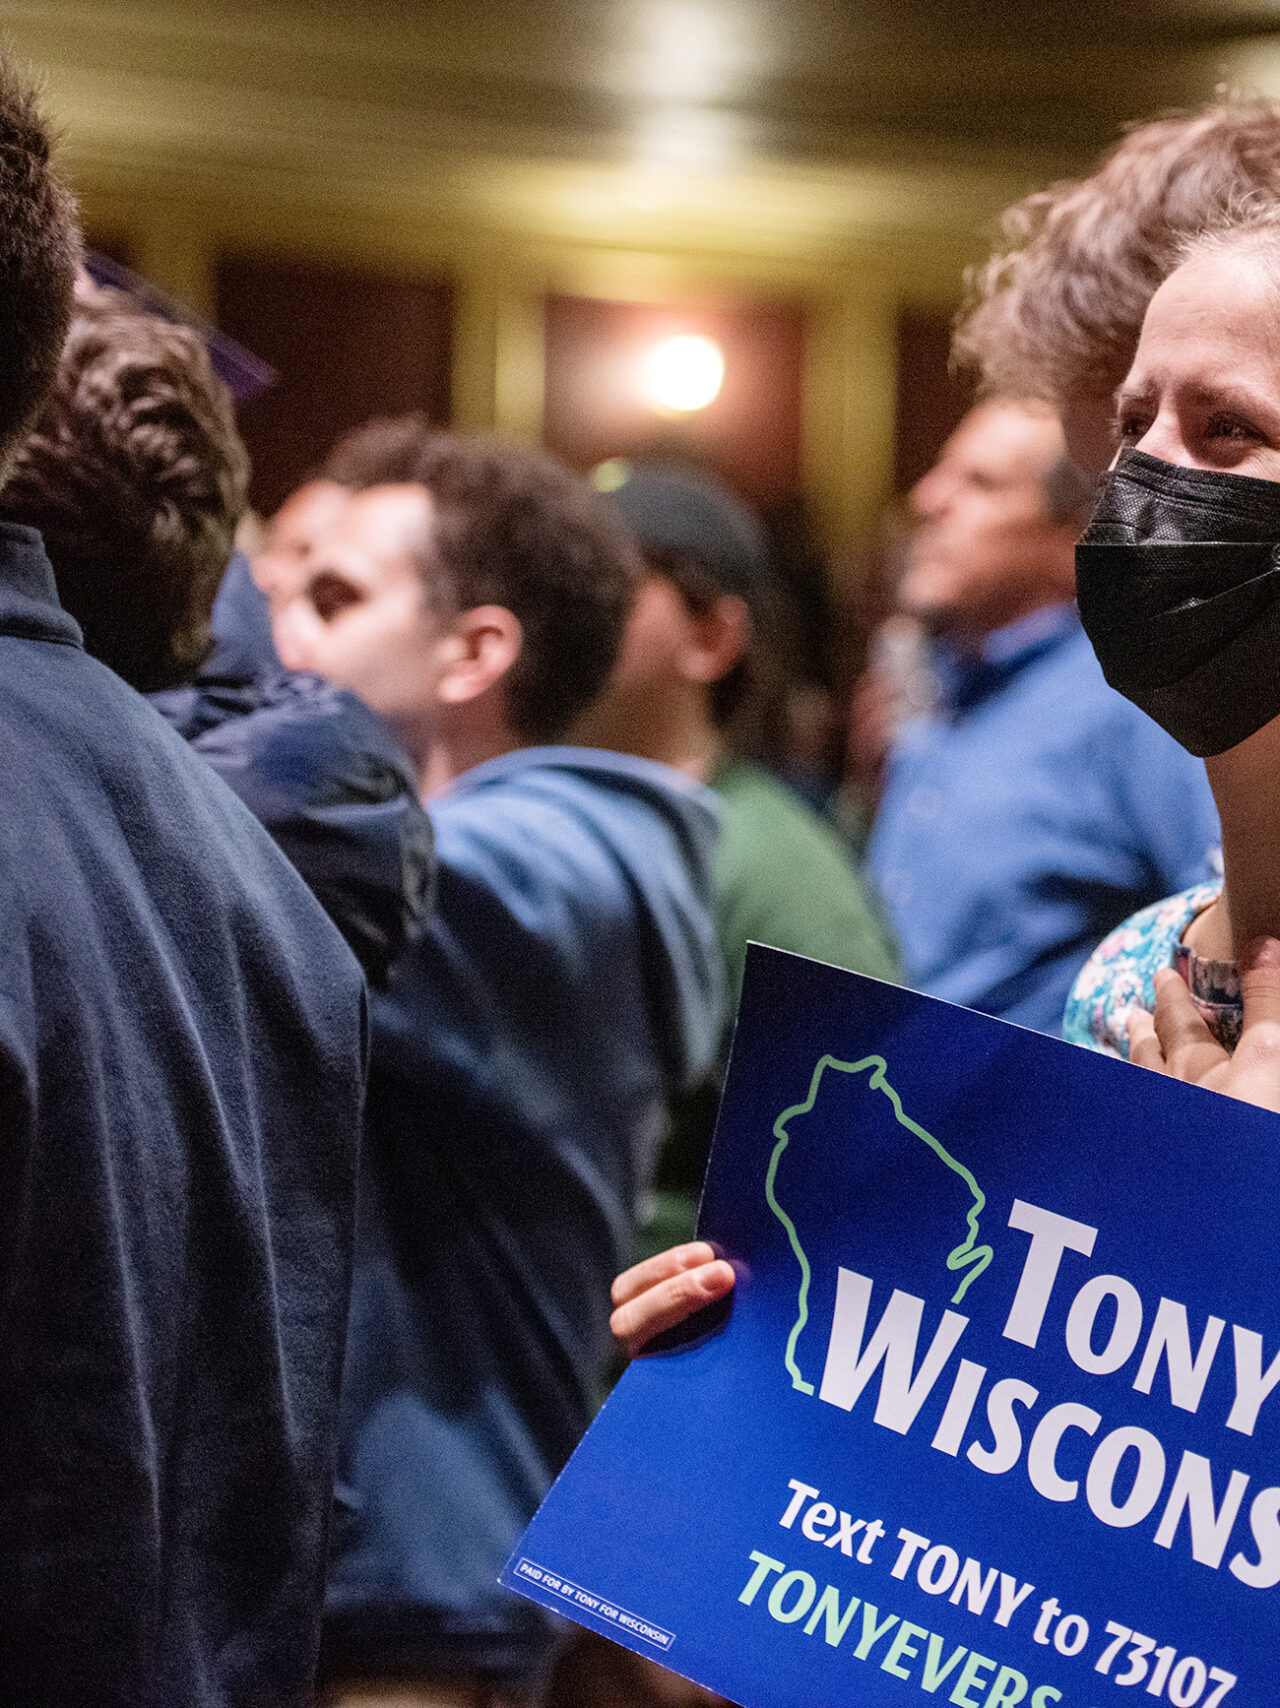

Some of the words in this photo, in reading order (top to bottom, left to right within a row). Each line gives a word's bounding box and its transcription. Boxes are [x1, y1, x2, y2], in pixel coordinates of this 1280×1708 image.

[520, 1563, 543, 1580] PAID
[542, 1574, 562, 1590] FOR
[560, 1584, 575, 1596] BY
[574, 1590, 600, 1609] TONY
[598, 1603, 619, 1619] FOR
[618, 1613, 670, 1645] WISCONSIN
[778, 1478, 887, 1565] Text
[890, 1527, 1036, 1628] TONY
[1032, 1597, 1091, 1657] to
[1094, 1620, 1239, 1708] 73107
